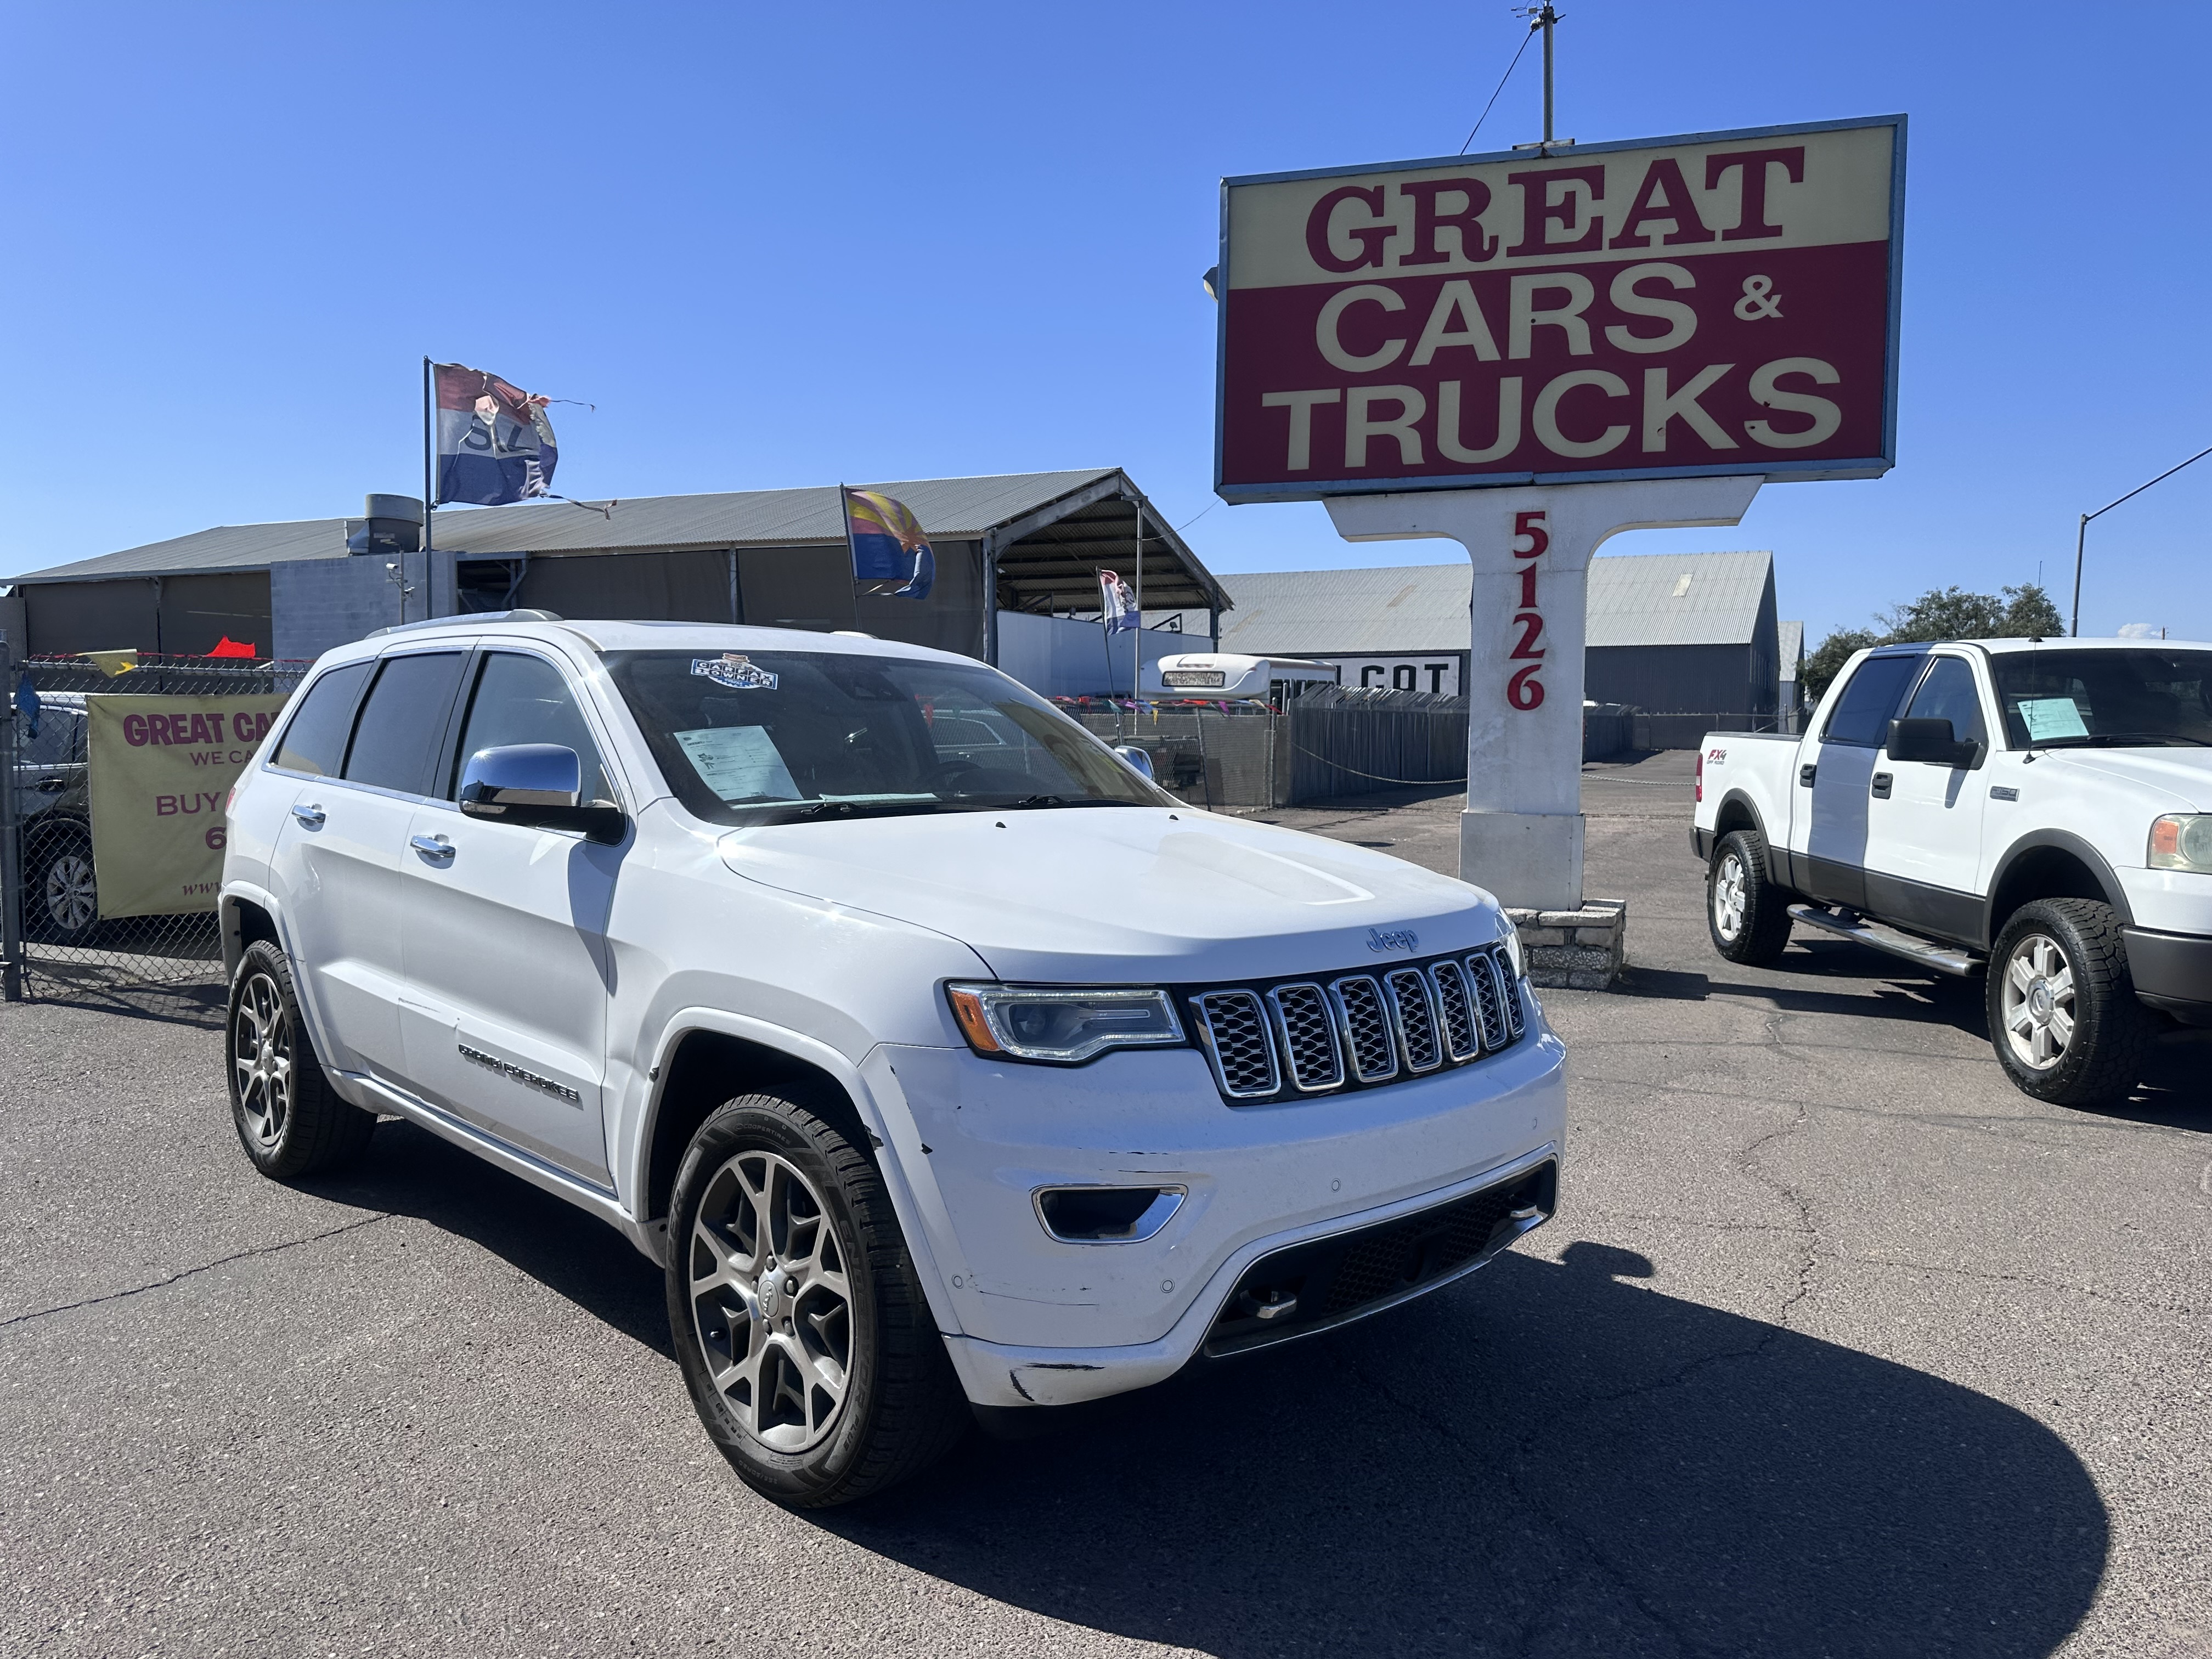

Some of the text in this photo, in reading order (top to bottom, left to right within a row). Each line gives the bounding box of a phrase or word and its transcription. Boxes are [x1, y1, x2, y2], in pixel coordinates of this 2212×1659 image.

[1306, 146, 1805, 273] GREAT
[1316, 262, 1784, 373] CARS &
[1262, 357, 1842, 470] TRUCKS
[1506, 510, 1549, 711] 5126
[698, 662, 772, 680] CARFAX
[123, 713, 225, 747] GREAT
[189, 751, 224, 766] WE
[1708, 749, 1727, 760] FX4
[156, 792, 222, 816] BUY
[205, 826, 227, 850] 6
[1366, 928, 1419, 952] Jeep
[504, 1062, 579, 1102] CHEROKEE
